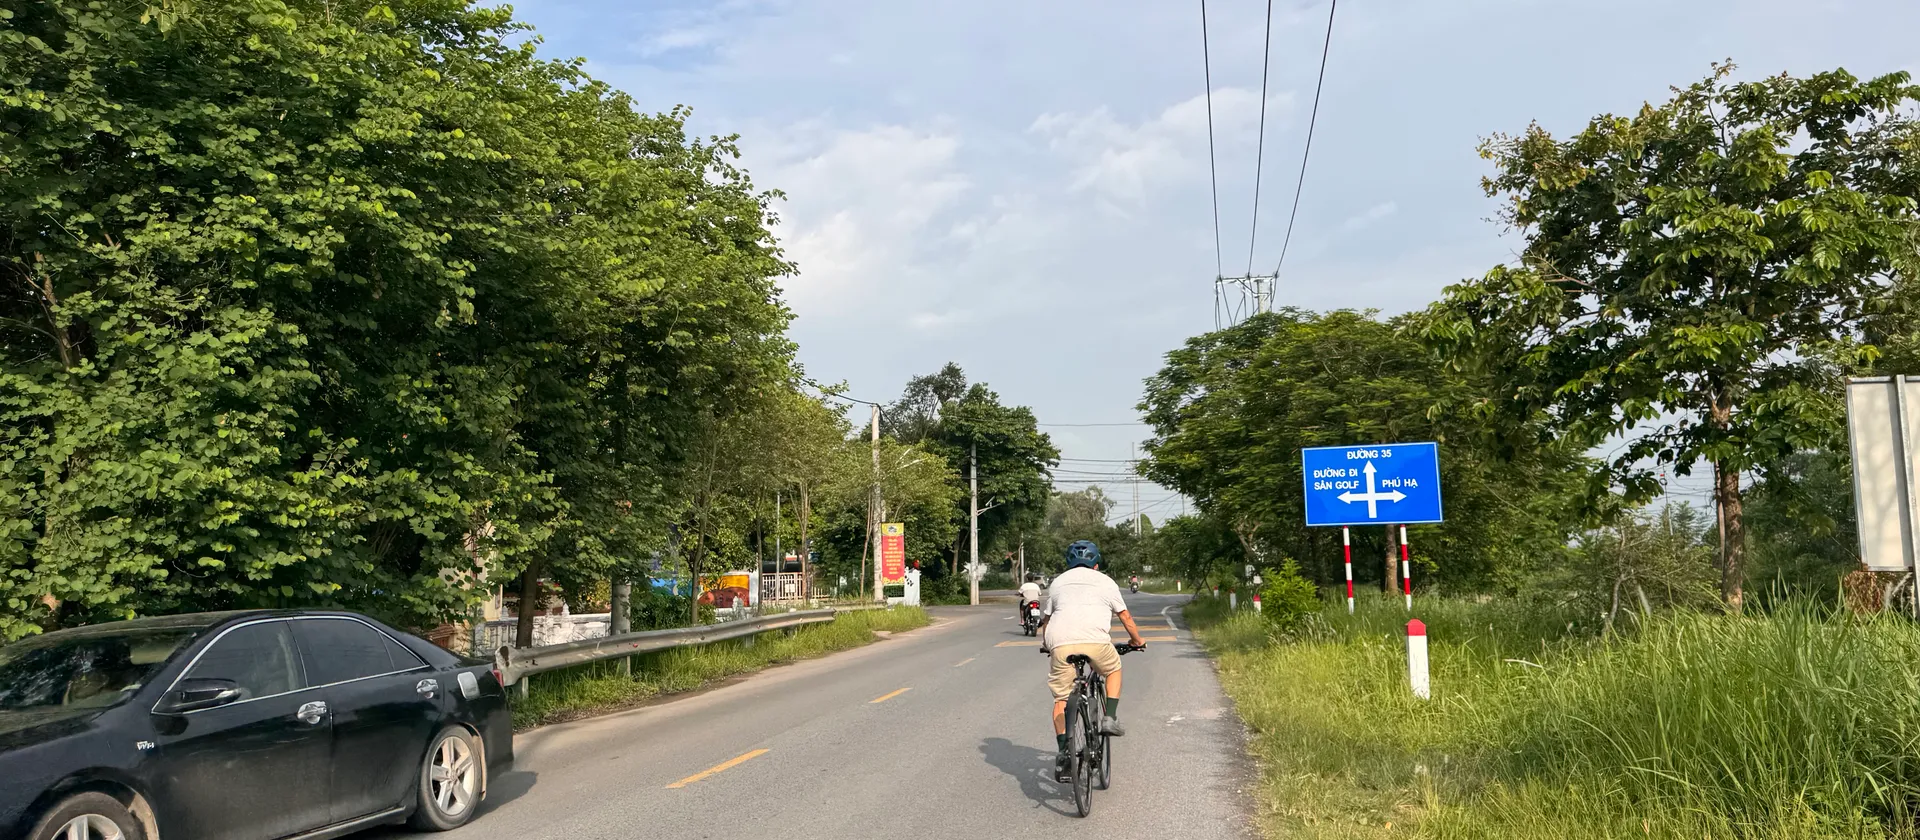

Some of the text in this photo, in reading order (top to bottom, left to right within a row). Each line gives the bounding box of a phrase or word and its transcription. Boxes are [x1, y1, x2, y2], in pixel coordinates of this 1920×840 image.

[1347, 448, 1392, 459] ĐƯỜNG 35
[1313, 467, 1358, 478] ĐƯỜNG ĐI
[1314, 479, 1359, 490] SÂN GOLF
[1382, 477, 1418, 488] PHÚ HẠ
